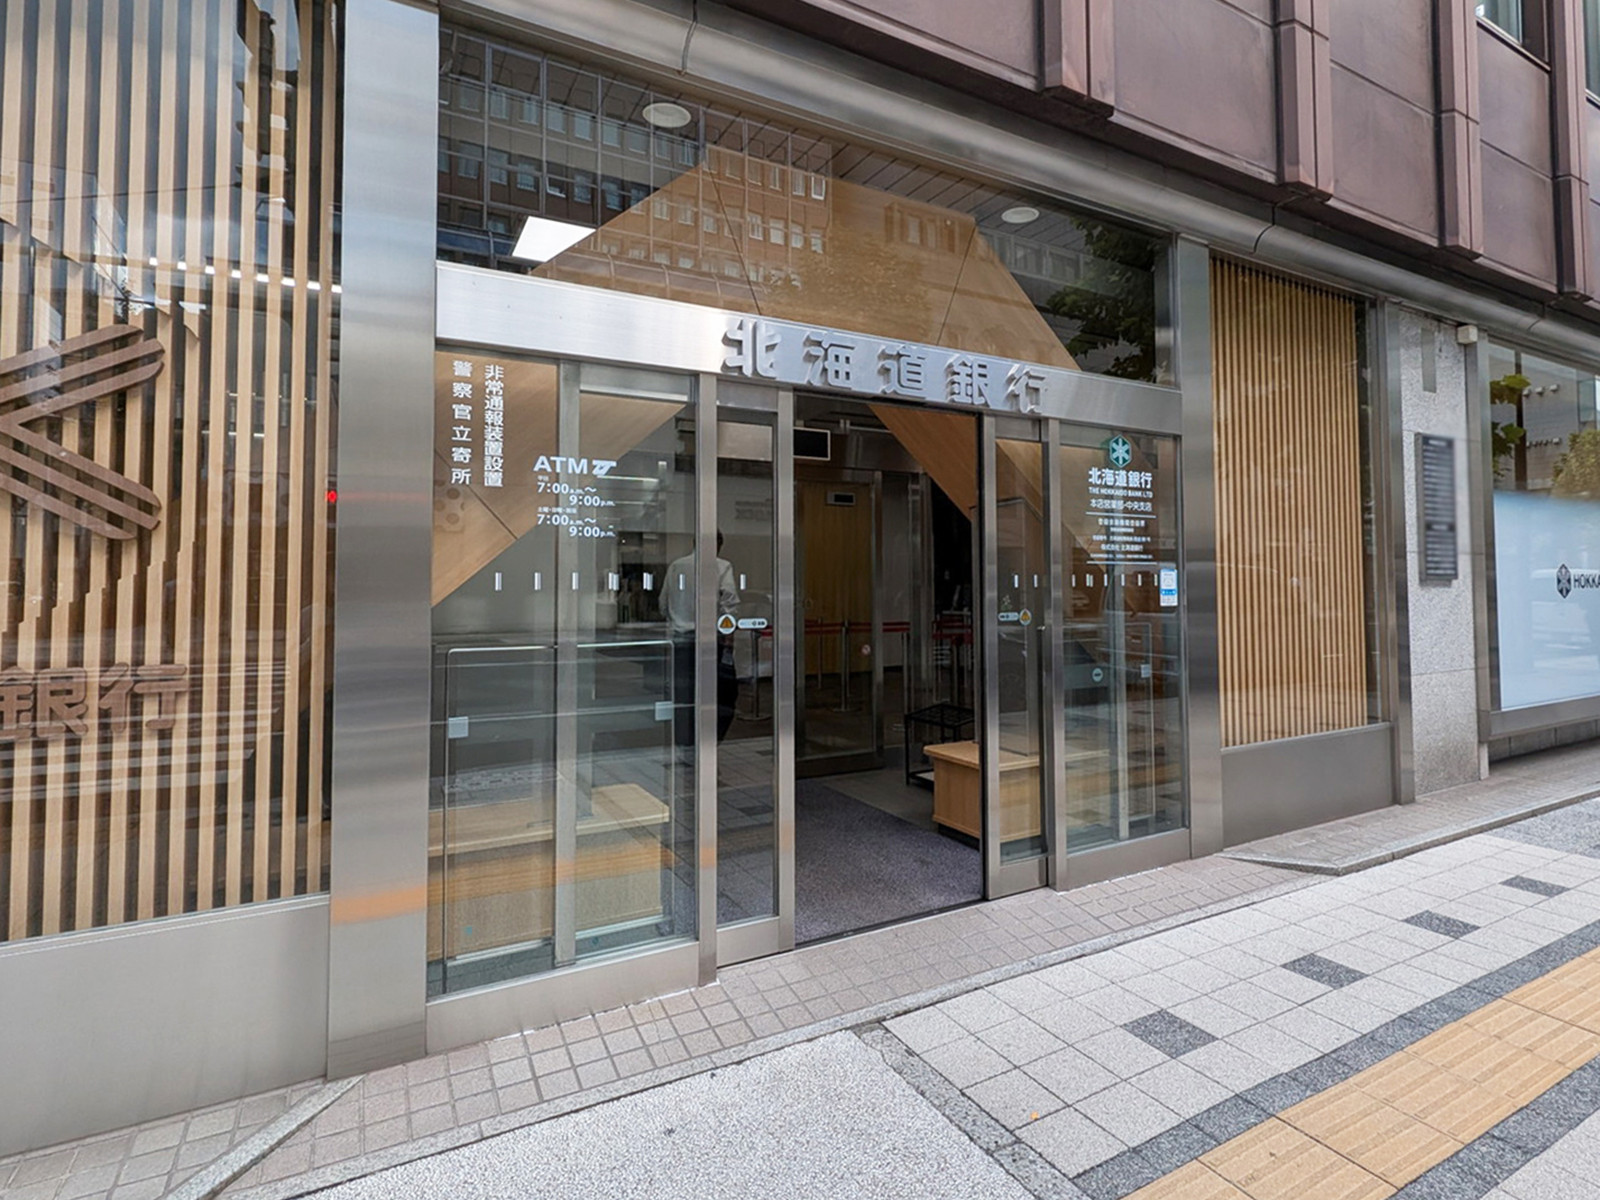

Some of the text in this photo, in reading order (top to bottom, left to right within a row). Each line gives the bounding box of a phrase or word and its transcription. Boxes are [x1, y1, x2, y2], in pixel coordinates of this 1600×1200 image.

[721, 317, 1048, 414] 北海道銀行
[451, 359, 473, 486] 警察官立寄所
[483, 364, 505, 488] 非常通報装置設置
[533, 455, 588, 475] ATM
[1088, 467, 1152, 489] 北海道銀行
